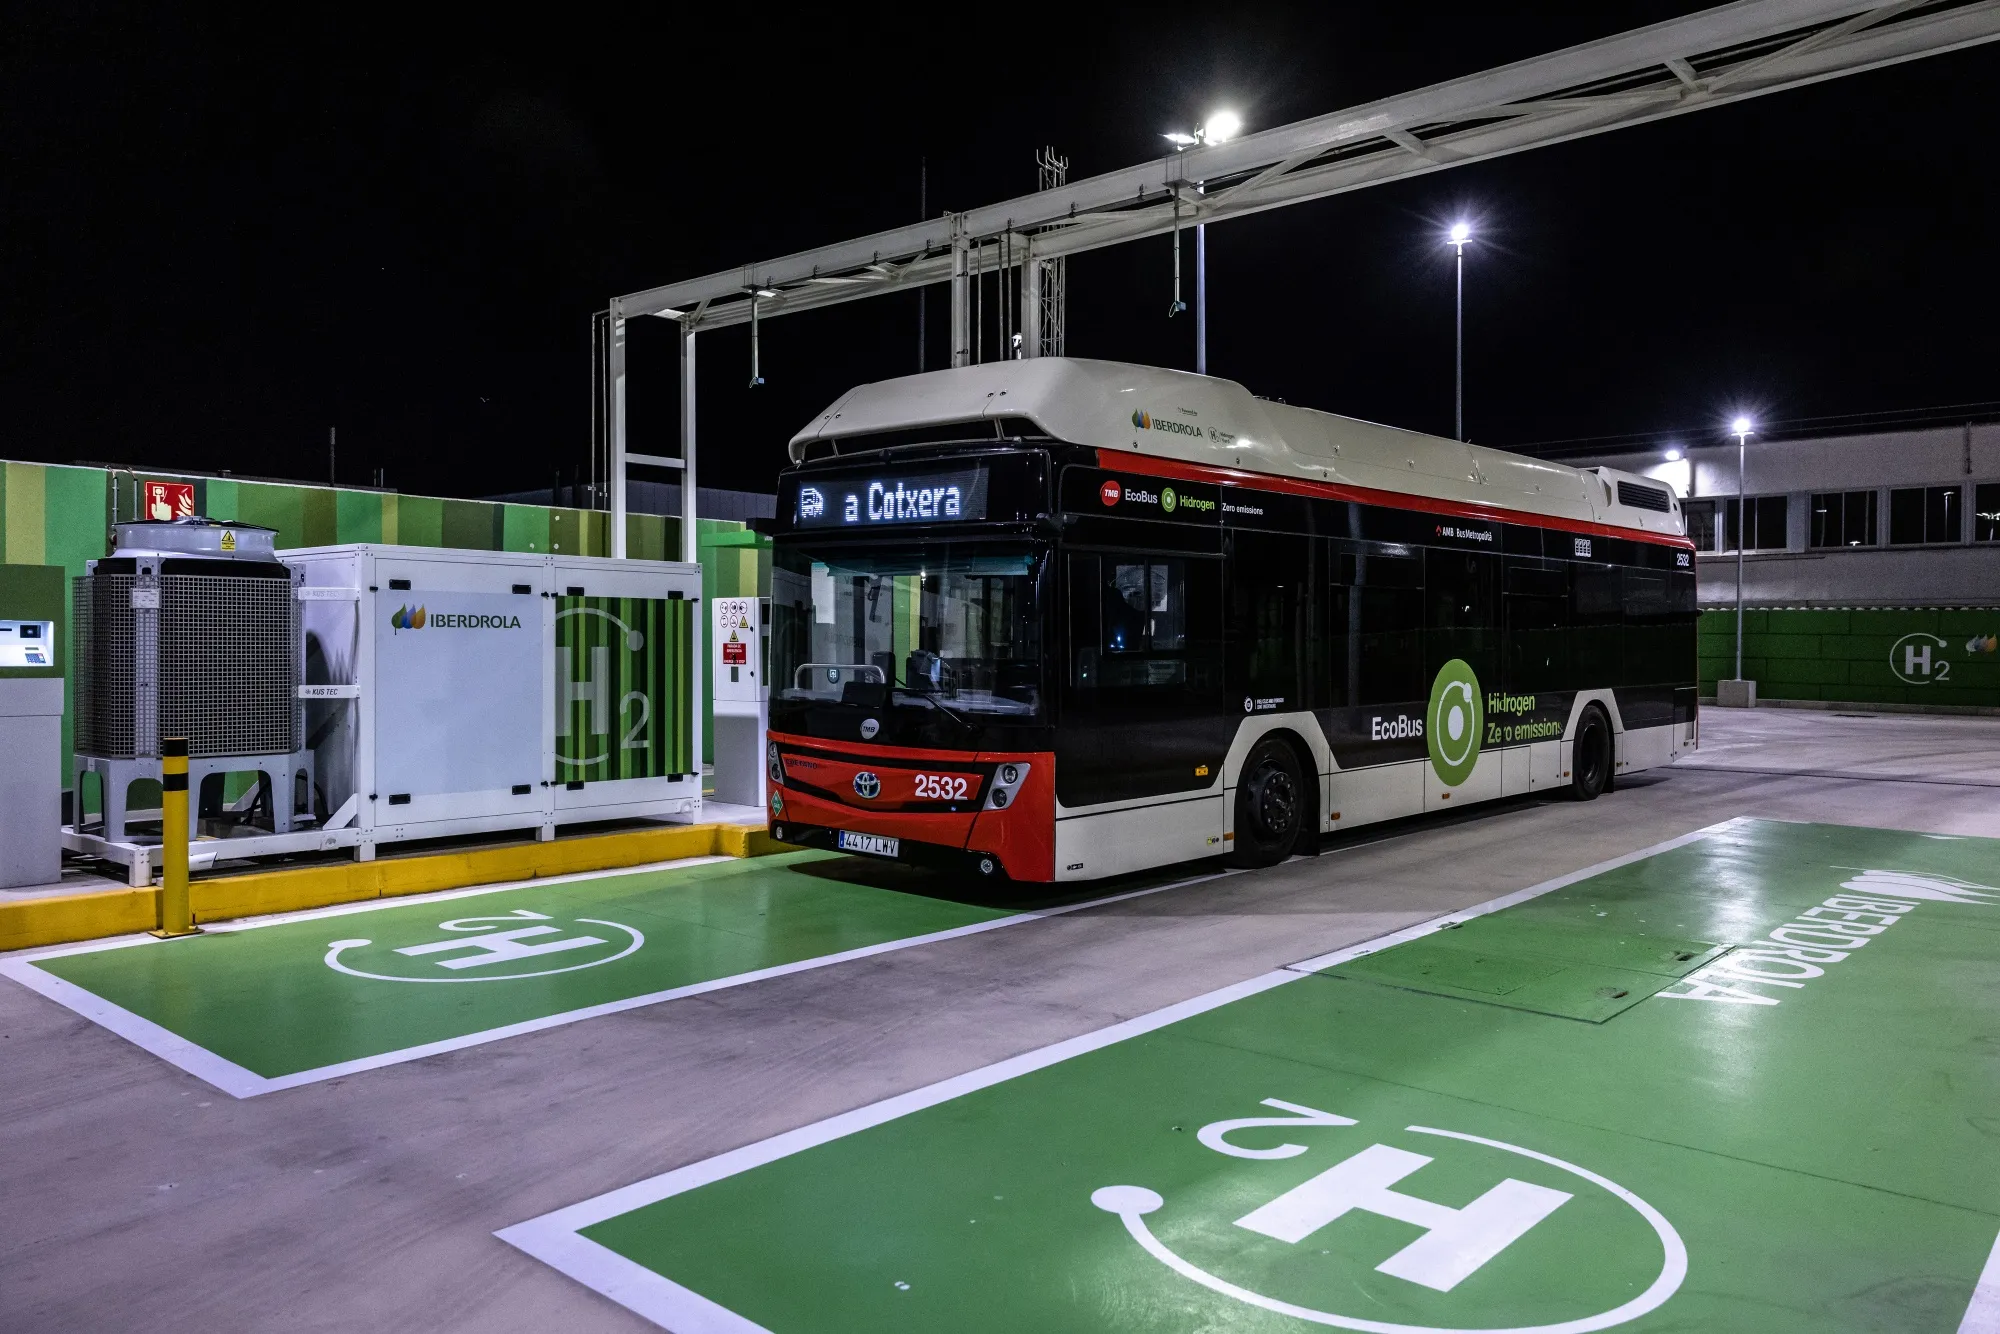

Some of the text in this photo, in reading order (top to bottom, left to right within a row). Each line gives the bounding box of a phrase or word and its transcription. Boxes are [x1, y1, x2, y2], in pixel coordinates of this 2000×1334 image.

[1152, 418, 1203, 438] IBERDROLA
[845, 482, 960, 521] a Cotxera
[1104, 489, 1119, 498] TMB
[1125, 488, 1264, 516] EcoBus Hidrogen Zero emissions
[1442, 527, 1455, 537] AMB
[1676, 552, 1690, 567] 2532
[430, 613, 521, 629] IBERDROLA
[312, 688, 339, 696] KUS TEC
[1488, 692, 1536, 717] Hidrogen
[862, 725, 876, 733] TMB
[1371, 714, 1423, 741] EcoBus
[1514, 717, 1563, 740] emissions
[914, 773, 969, 801] 2532
[846, 832, 896, 855] 4417 LWV
[1654, 893, 1922, 1006] IBERDROLA
